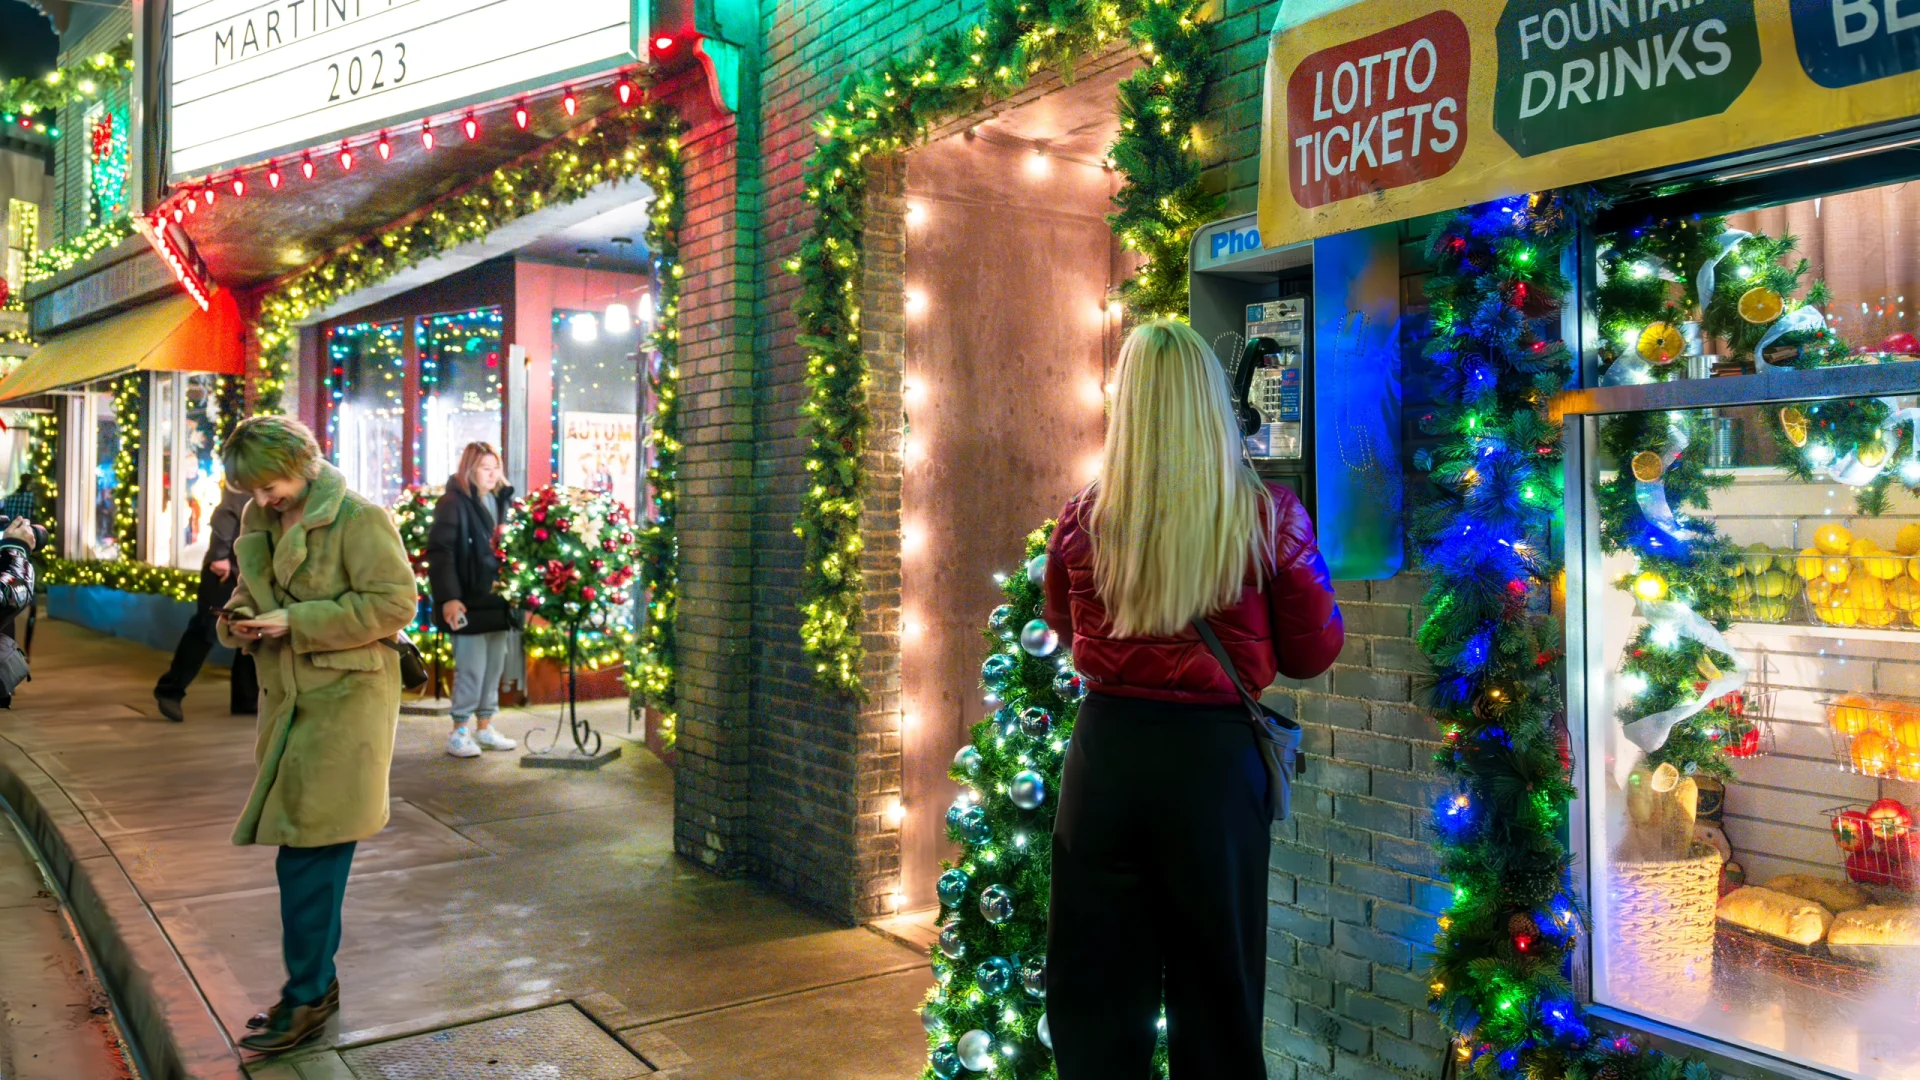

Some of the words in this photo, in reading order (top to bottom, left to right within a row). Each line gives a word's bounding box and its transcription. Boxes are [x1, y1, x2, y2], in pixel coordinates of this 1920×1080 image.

[1518, 0, 1705, 61] FOUN
[327, 42, 407, 103] 2023
[1313, 38, 1438, 122] LOTTO
[1518, 18, 1732, 120] DRINKS
[1295, 96, 1459, 187] TICKETS
[1210, 228, 1261, 259] Pho
[567, 419, 636, 441] AUTUM
